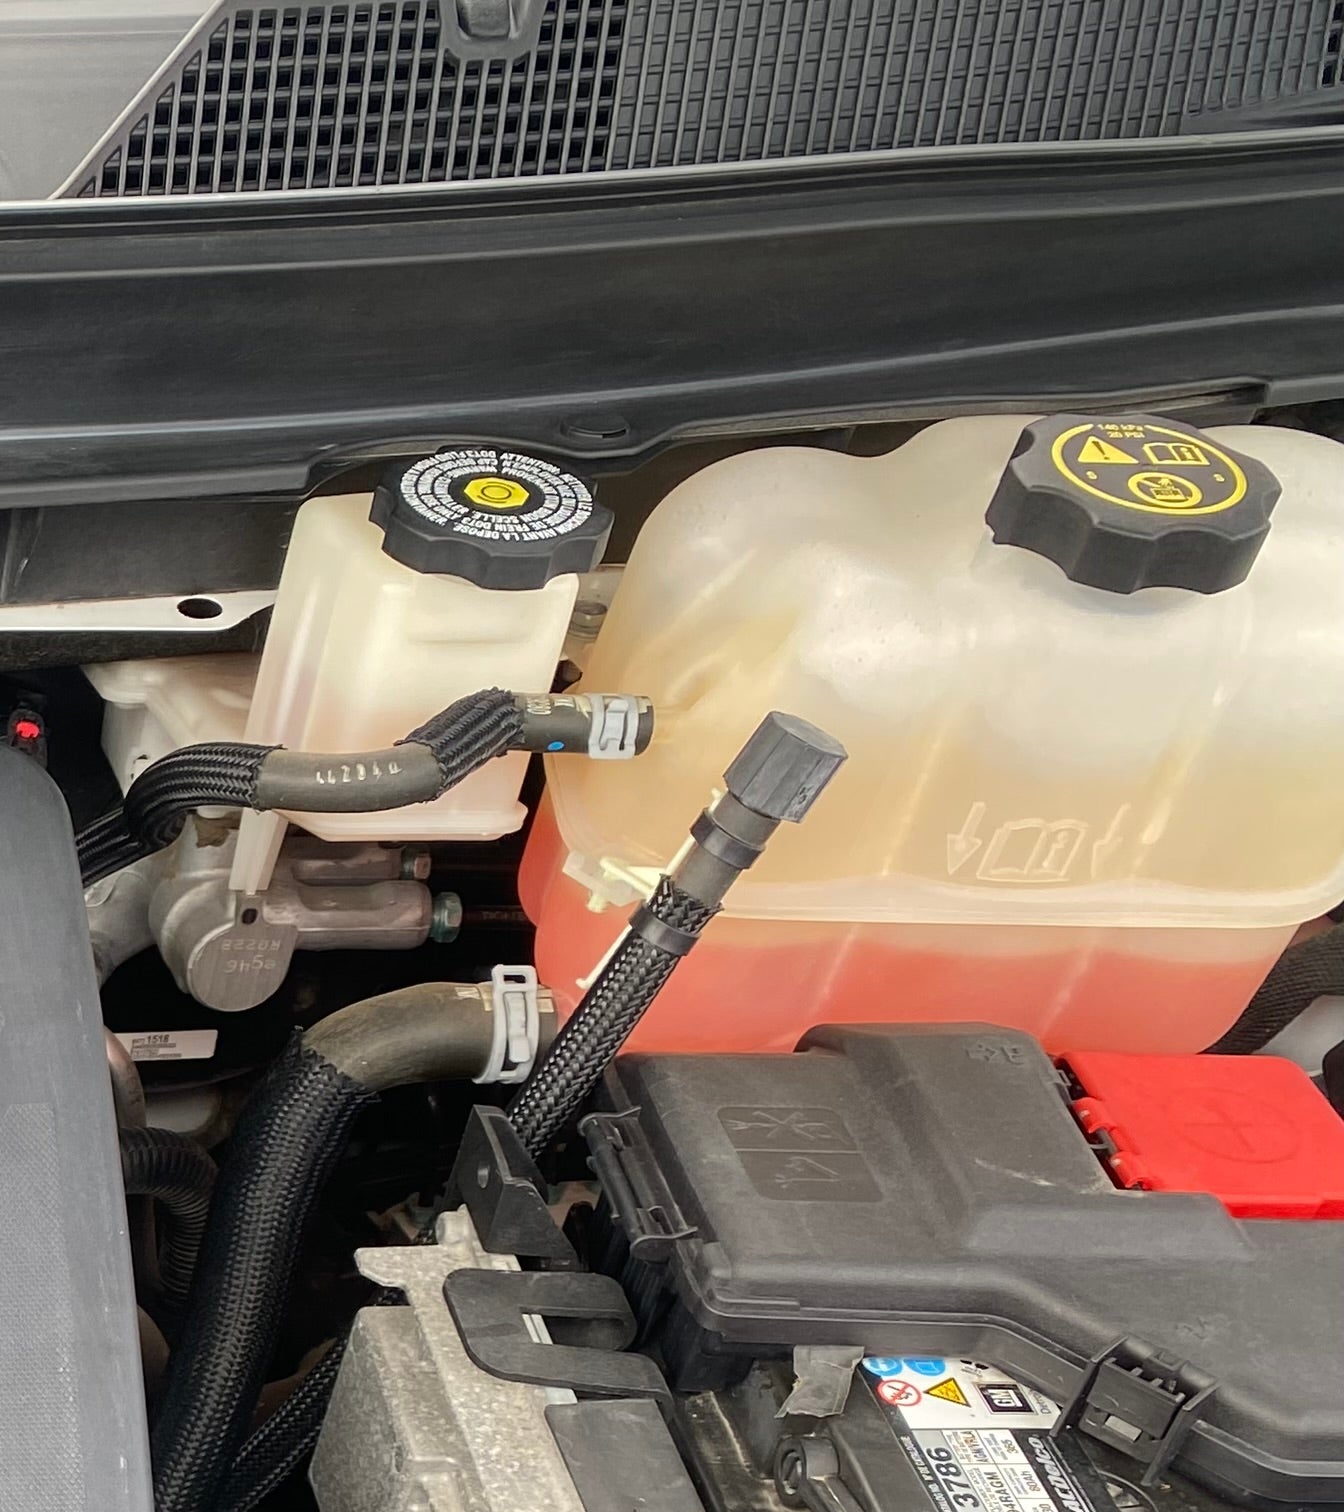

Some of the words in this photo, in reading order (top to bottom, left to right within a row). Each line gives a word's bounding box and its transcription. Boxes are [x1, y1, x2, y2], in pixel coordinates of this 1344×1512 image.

[501, 532, 520, 540] LA
[987, 1389, 1015, 1406] GM
[926, 1448, 979, 1507] 3786
